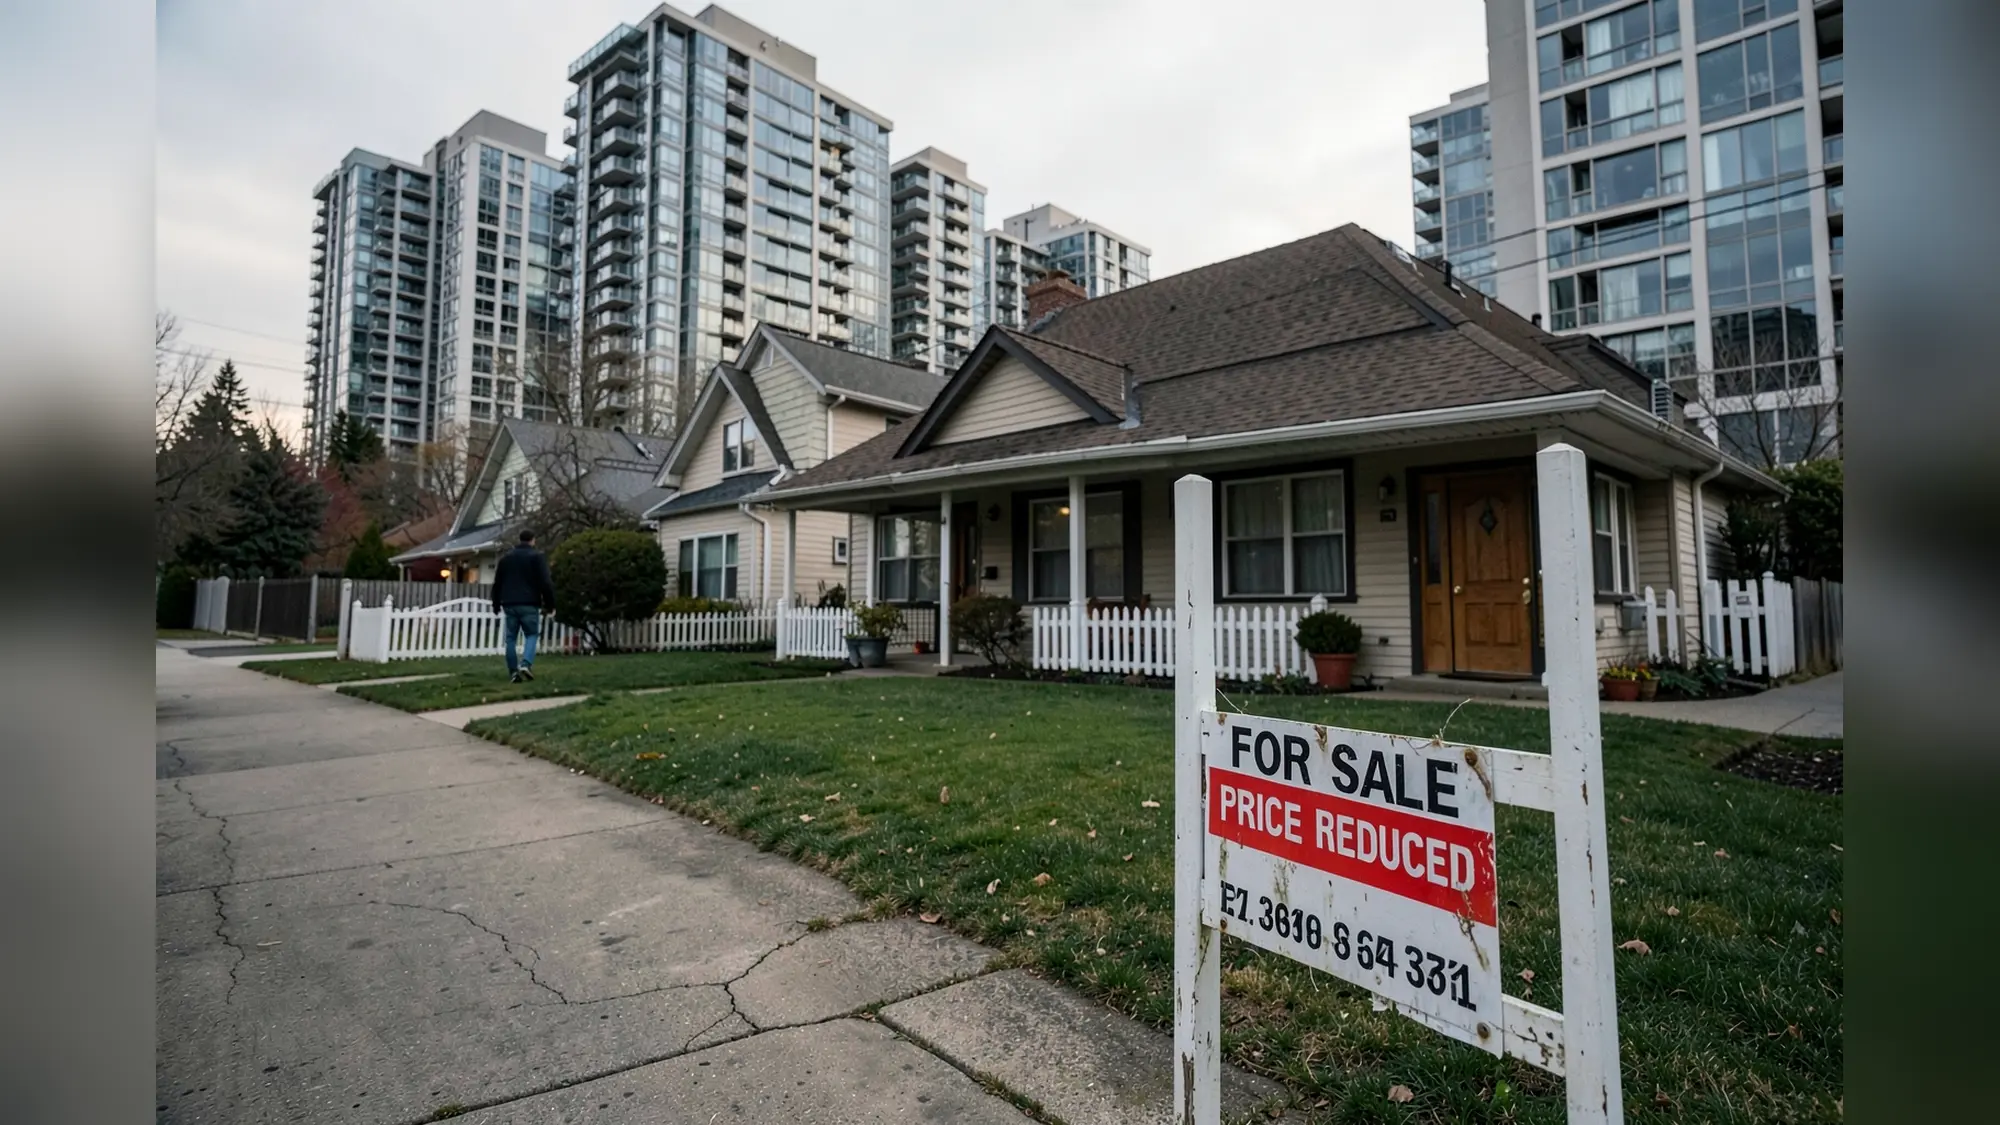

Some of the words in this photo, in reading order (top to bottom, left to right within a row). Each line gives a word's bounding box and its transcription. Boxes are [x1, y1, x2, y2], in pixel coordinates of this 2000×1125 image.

[1232, 725, 1311, 786] FOR
[1331, 743, 1459, 819] SALE
[1220, 784, 1303, 845] PRICE
[1315, 808, 1475, 892] REDUCED
